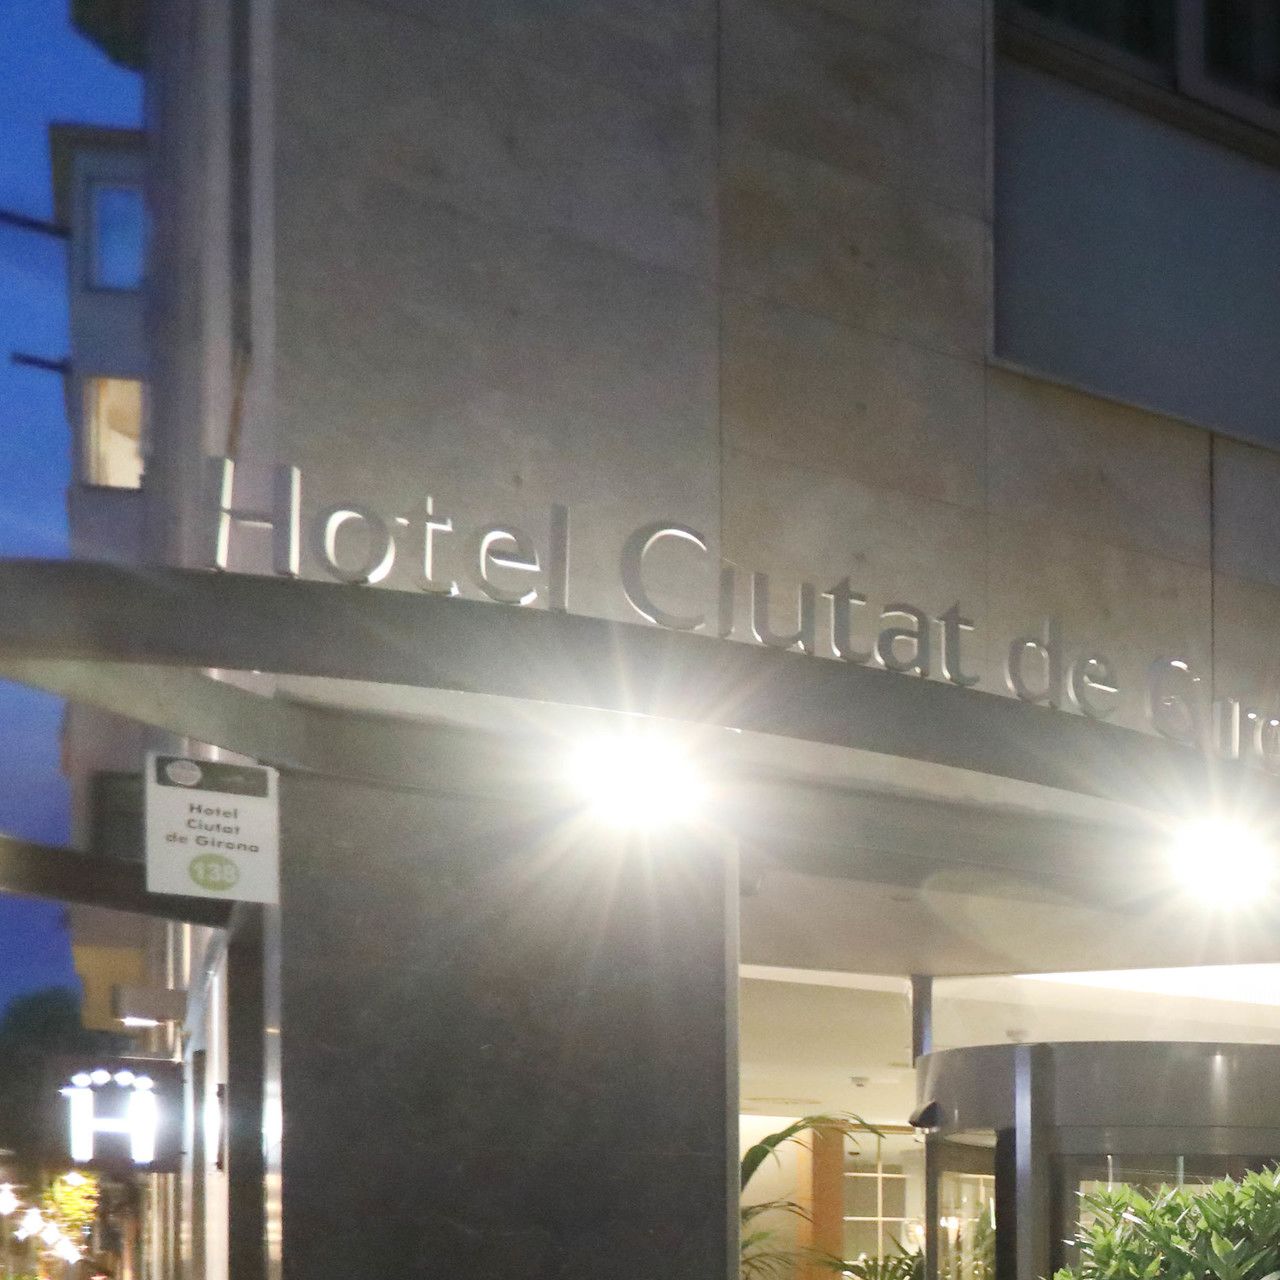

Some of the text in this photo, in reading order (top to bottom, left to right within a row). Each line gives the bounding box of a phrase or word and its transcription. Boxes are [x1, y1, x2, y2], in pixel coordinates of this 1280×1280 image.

[206, 456, 571, 613] Hotel
[620, 518, 980, 688] Ciutat
[1004, 616, 1119, 722] de
[189, 803, 239, 820] Hotel
[187, 818, 241, 835] Ciutat
[165, 831, 260, 853] de Girona
